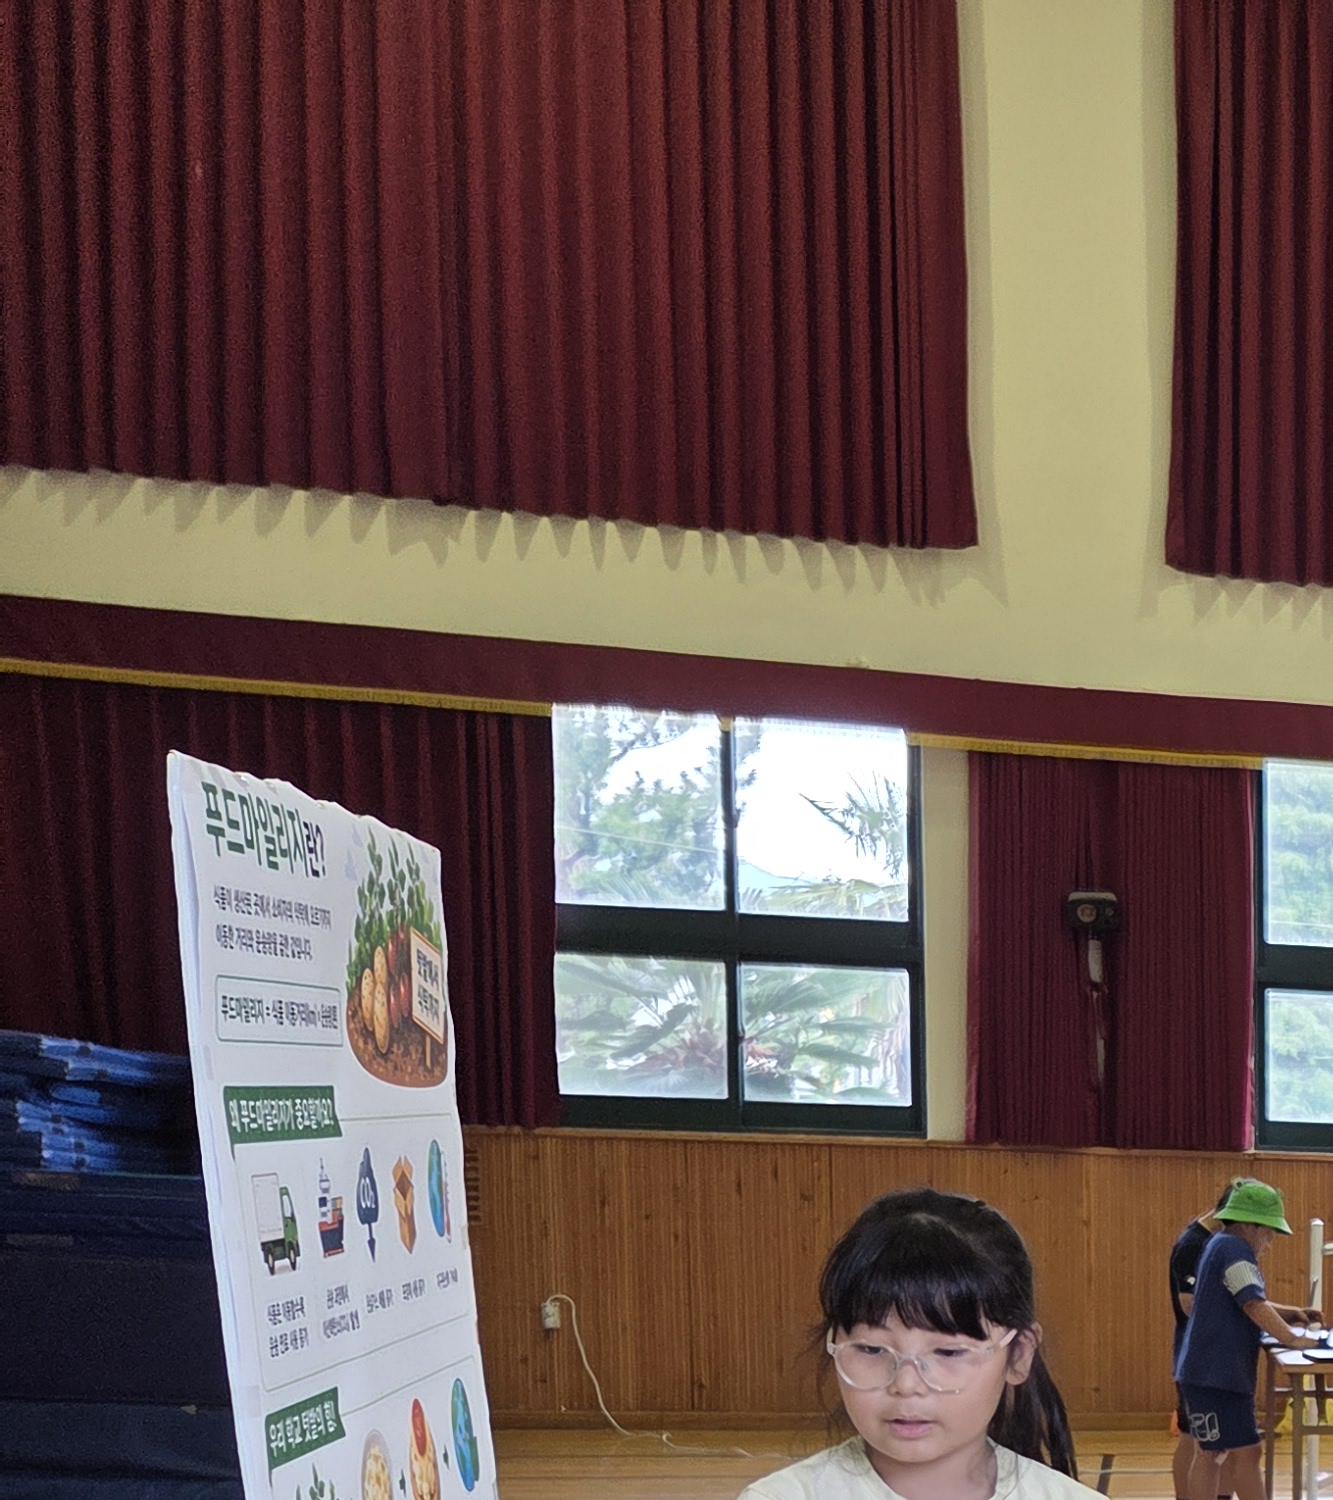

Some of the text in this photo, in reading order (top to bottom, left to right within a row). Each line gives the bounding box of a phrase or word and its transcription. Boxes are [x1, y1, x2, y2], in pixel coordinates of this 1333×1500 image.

[201, 781, 326, 878] 푸드마일리지란?
[222, 995, 264, 1024] 푸드마일리지
[230, 1098, 334, 1132] 왜 푸드마일리지가 중요할까요?
[270, 1421, 286, 1456] 우리
[286, 1416, 302, 1447] 학교
[302, 1405, 325, 1440] 텃밭의
